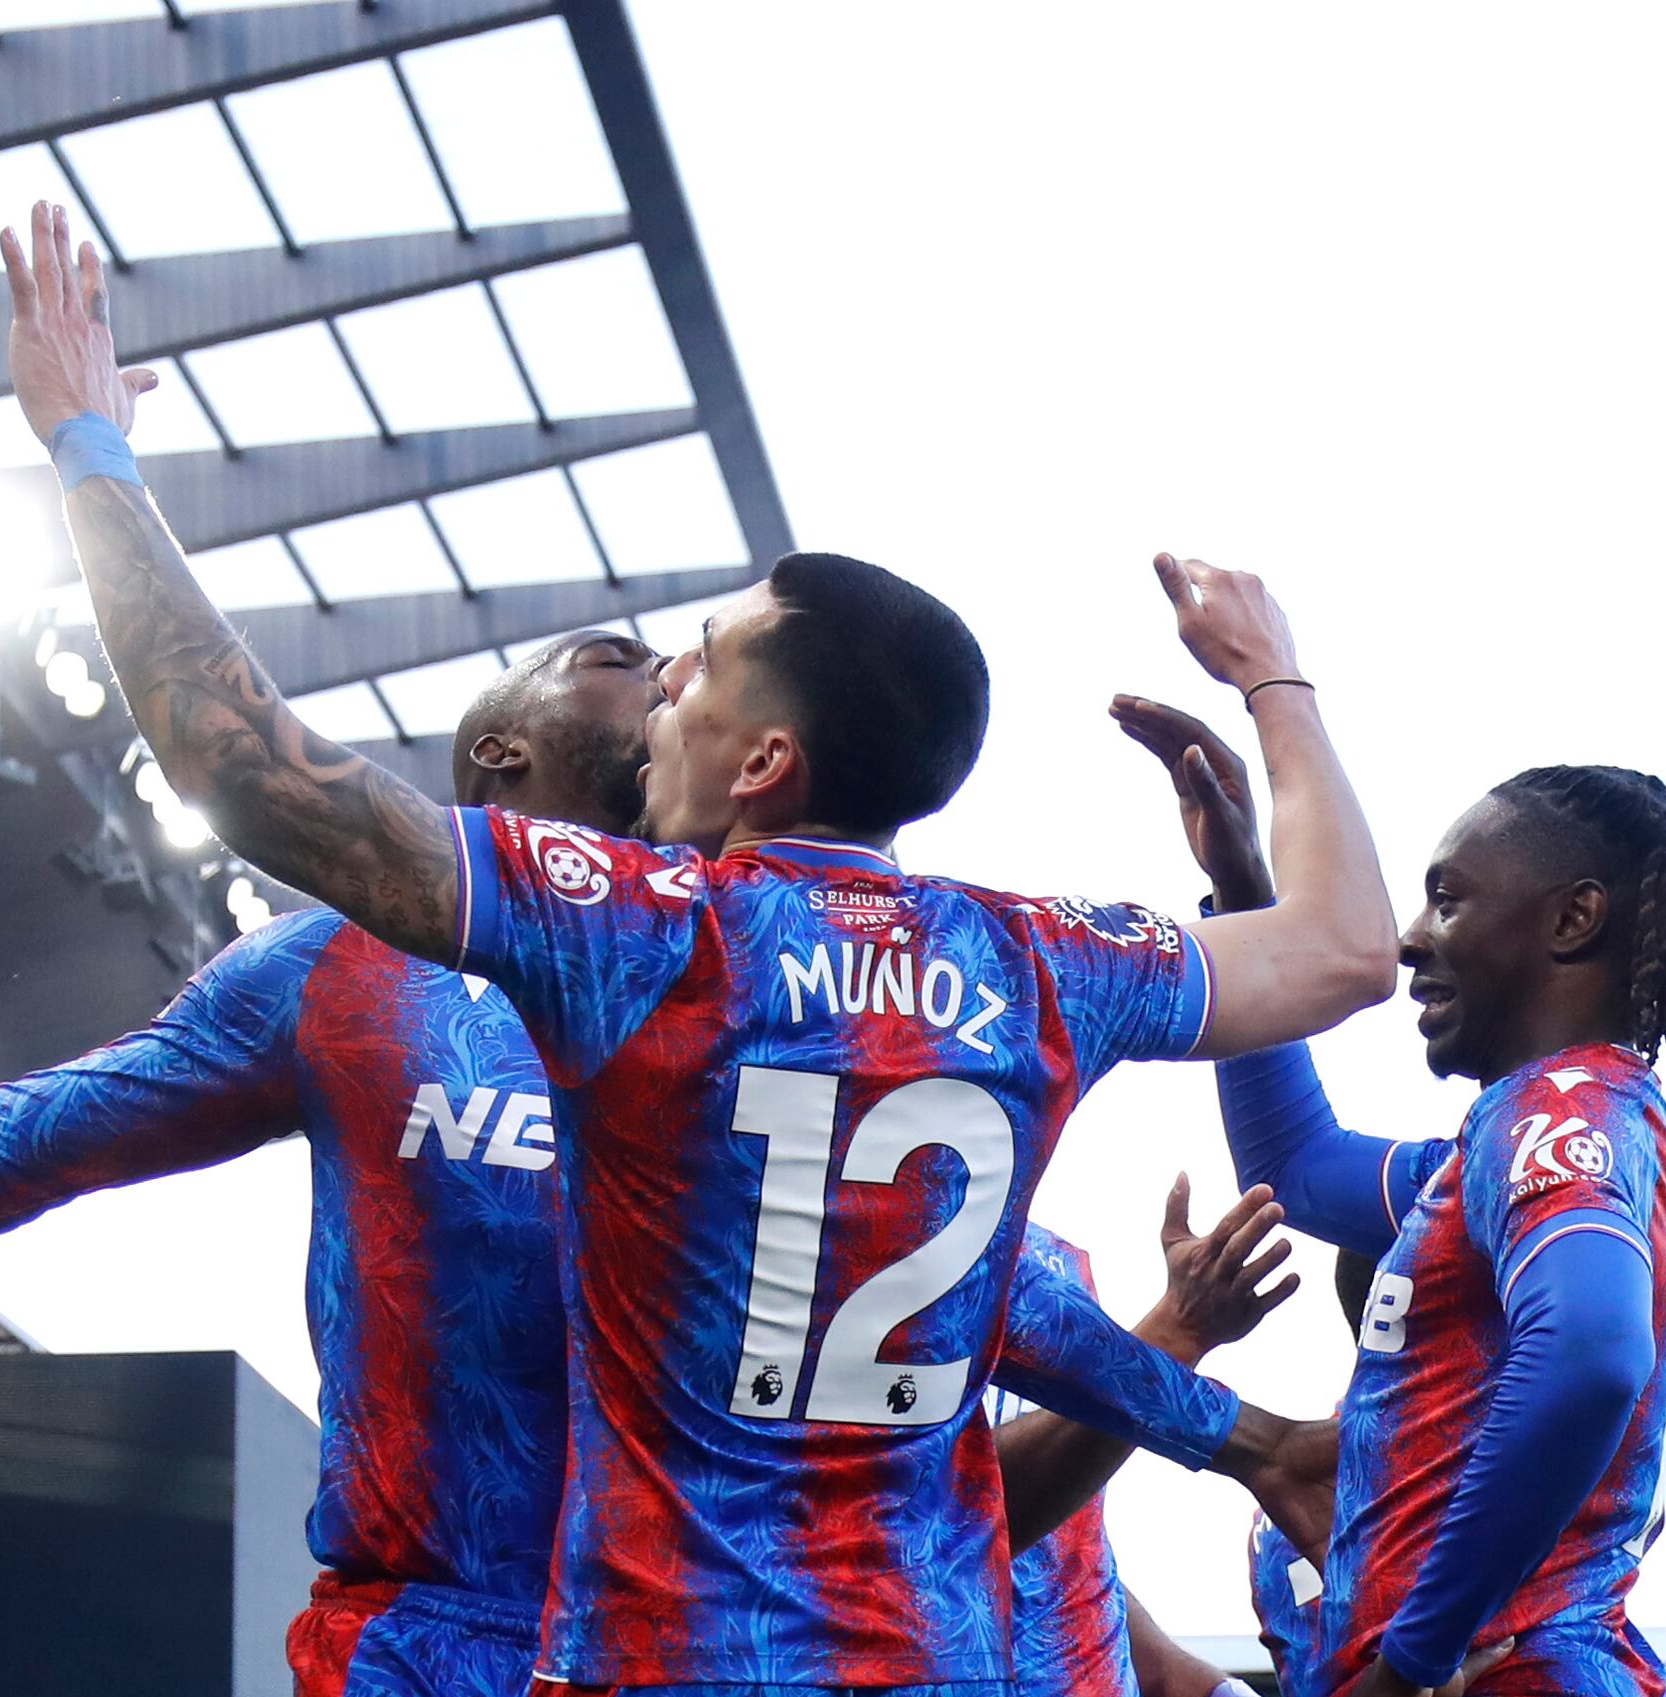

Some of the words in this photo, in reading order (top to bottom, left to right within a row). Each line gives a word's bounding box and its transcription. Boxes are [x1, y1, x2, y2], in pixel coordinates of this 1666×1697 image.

[809, 890, 917, 909] SELHURST
[843, 913, 895, 925] PARK
[779, 926, 1008, 1055] MUÑOZ
[728, 1065, 1015, 1425] 12
